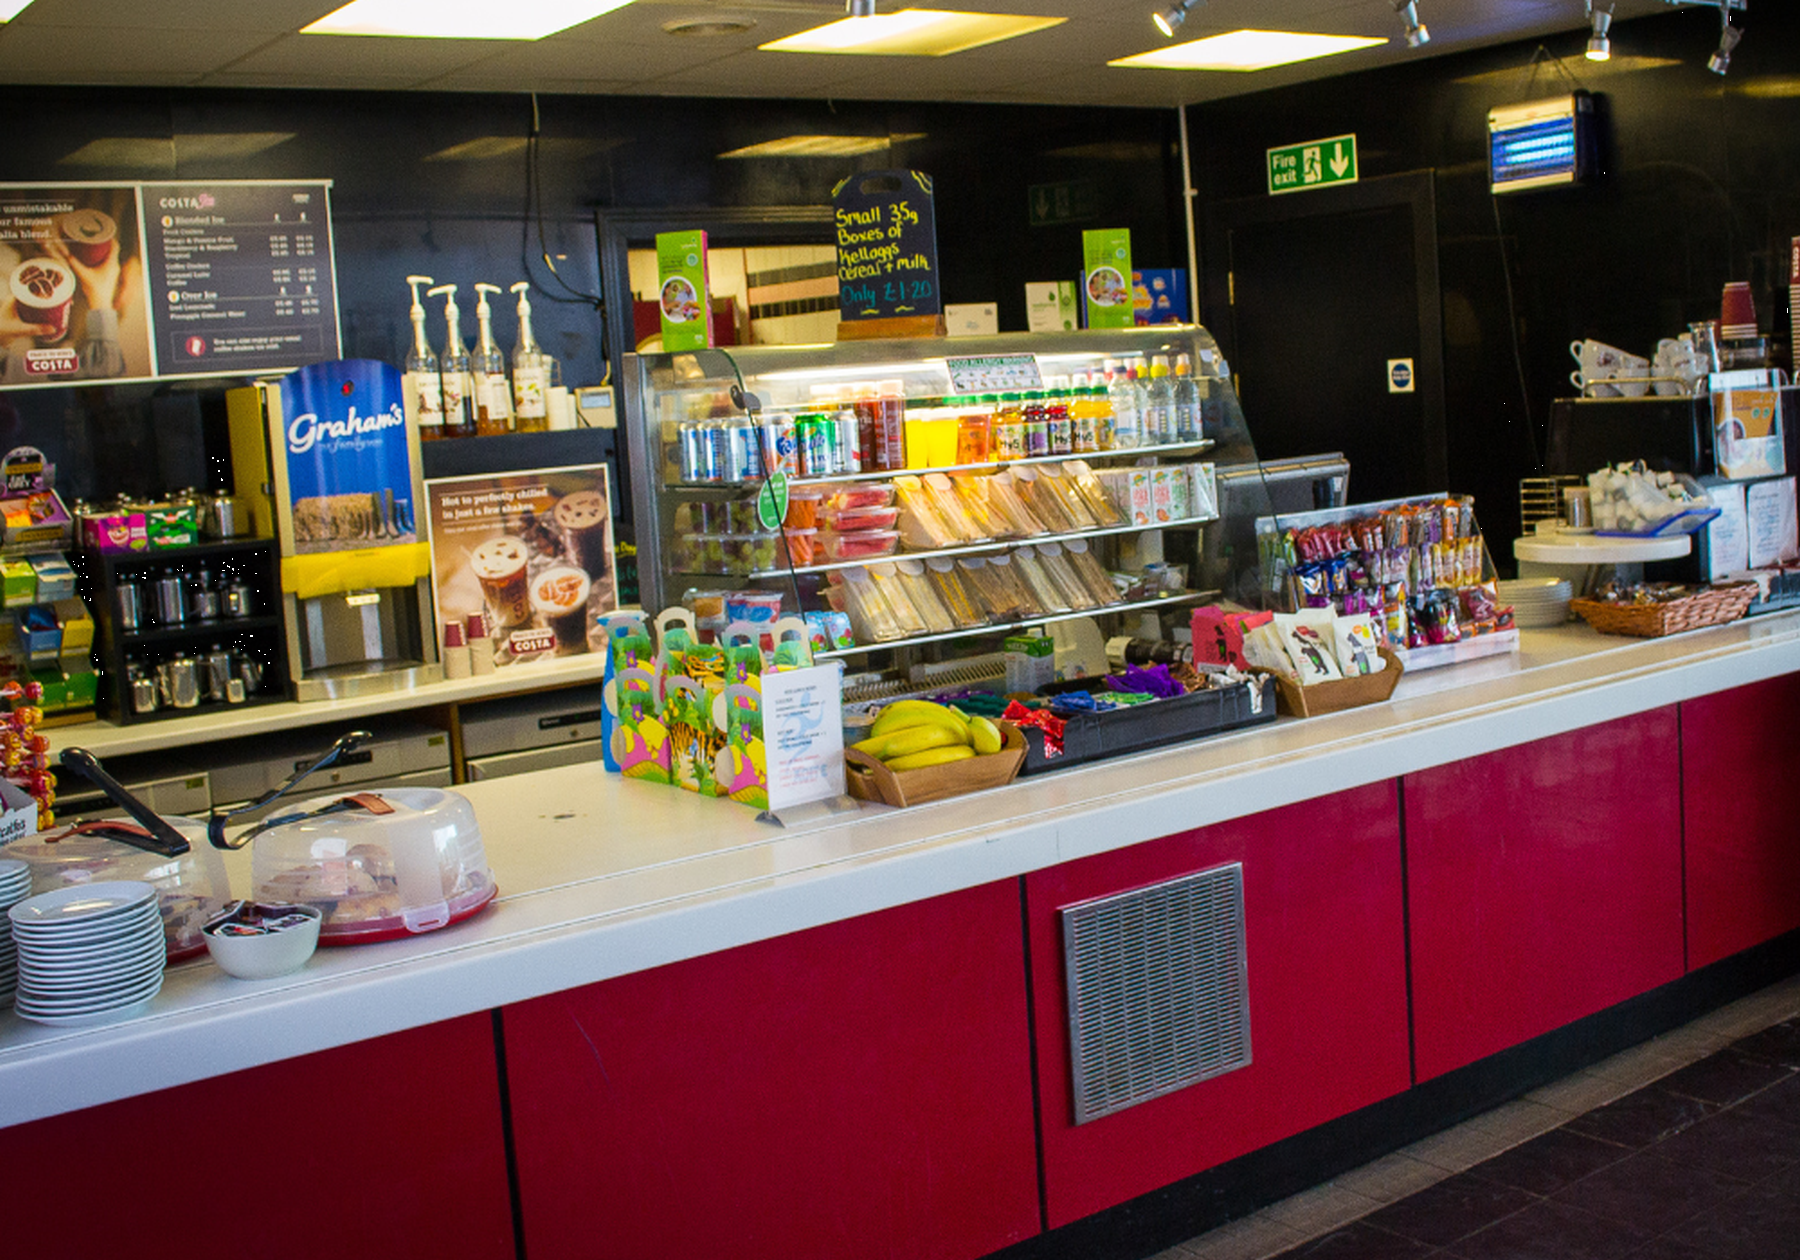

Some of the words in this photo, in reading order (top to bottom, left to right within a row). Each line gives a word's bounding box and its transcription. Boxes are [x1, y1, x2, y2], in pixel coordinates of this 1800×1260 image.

[1272, 153, 1297, 169] Fire
[1273, 168, 1298, 186] exit
[2, 203, 75, 214] unmistakable
[159, 197, 199, 209] COSTA
[14, 217, 53, 226] famous
[836, 206, 881, 228] Small
[888, 201, 919, 225] 35g
[837, 228, 885, 246] Boxes
[887, 219, 904, 239] of
[838, 242, 900, 267] Kelloggs
[896, 253, 932, 272] milk
[841, 283, 877, 309] Only
[31, 359, 73, 371] COSTA
[288, 403, 403, 454] Graham's
[441, 496, 460, 506] Hot
[461, 496, 472, 505] to
[473, 492, 515, 506] perfectly
[516, 487, 549, 499] chilled
[514, 638, 551, 652] COSTA
